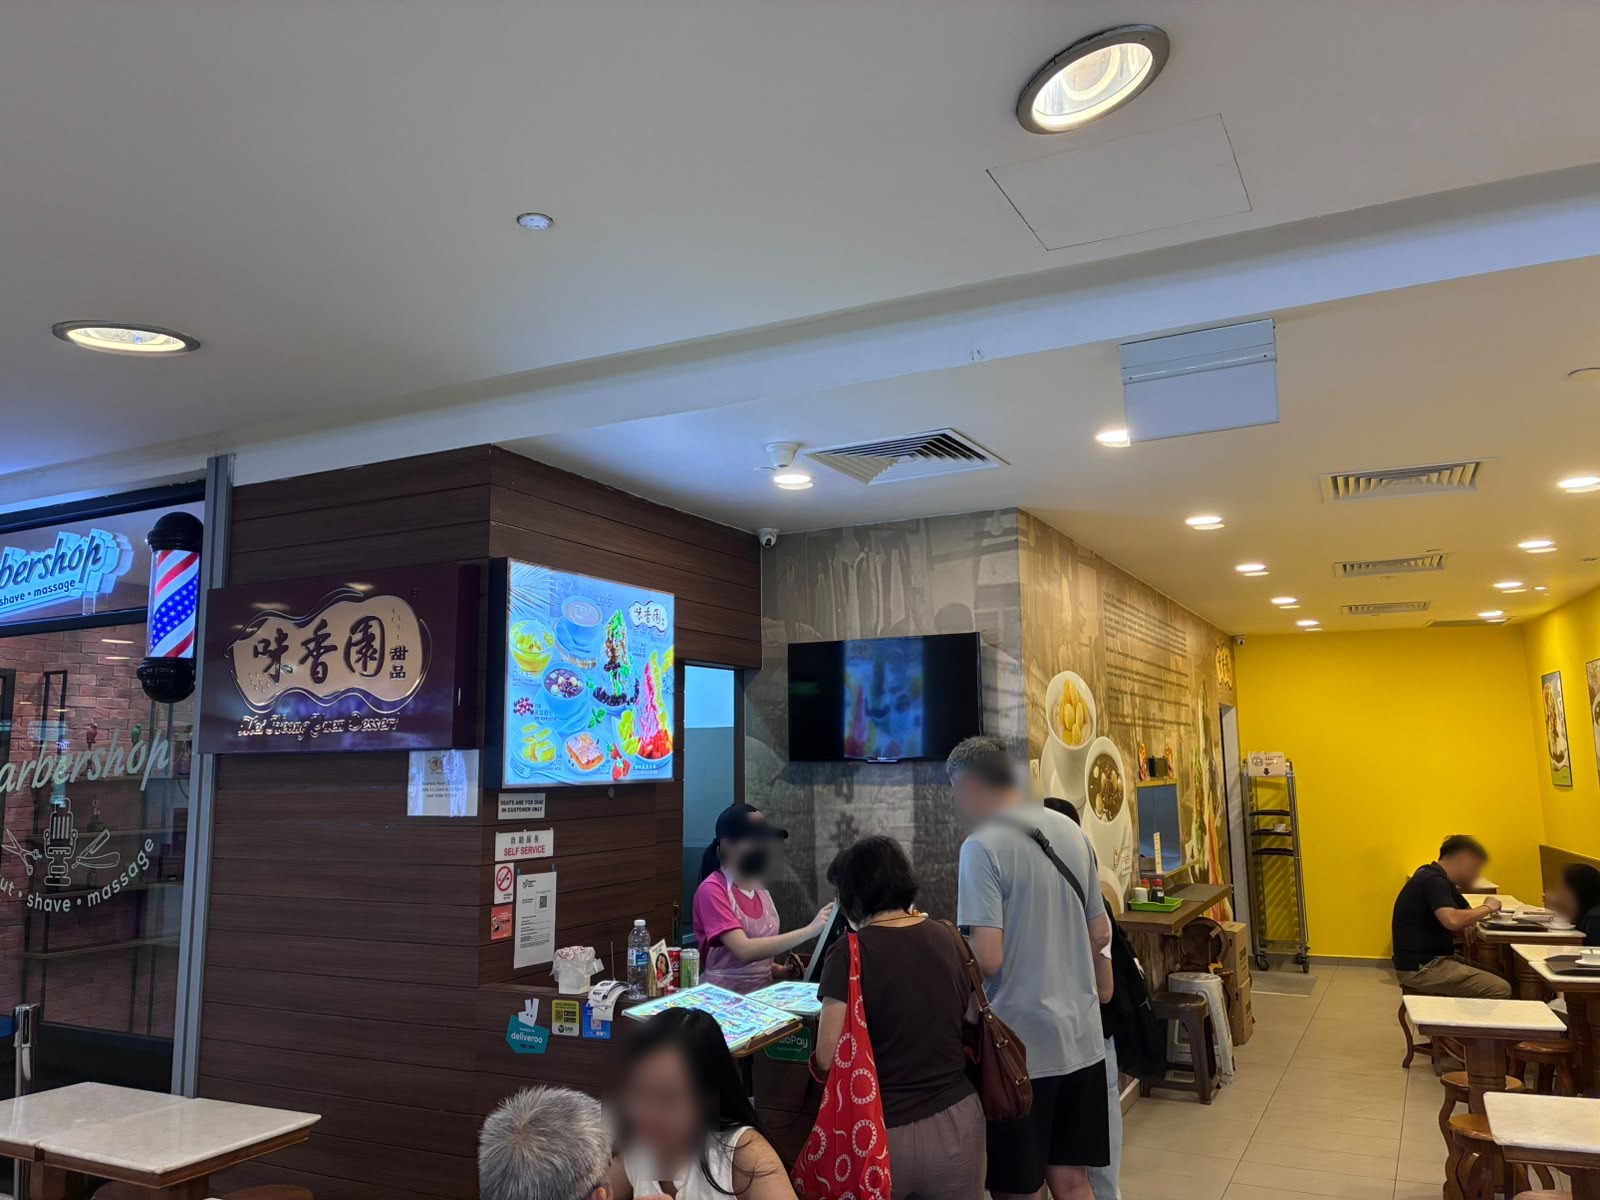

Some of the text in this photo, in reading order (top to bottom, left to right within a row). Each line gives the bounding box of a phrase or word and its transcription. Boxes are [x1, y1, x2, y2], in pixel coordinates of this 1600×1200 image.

[33, 579, 76, 597] massage
[388, 645, 408, 680] 甜品
[348, 710, 400, 732] Dessert
[0, 728, 169, 792] arbershop
[504, 845, 546, 856] SELF SERVICE
[0, 838, 154, 912] ut shave massage
[511, 1031, 543, 1043] deliveroo
